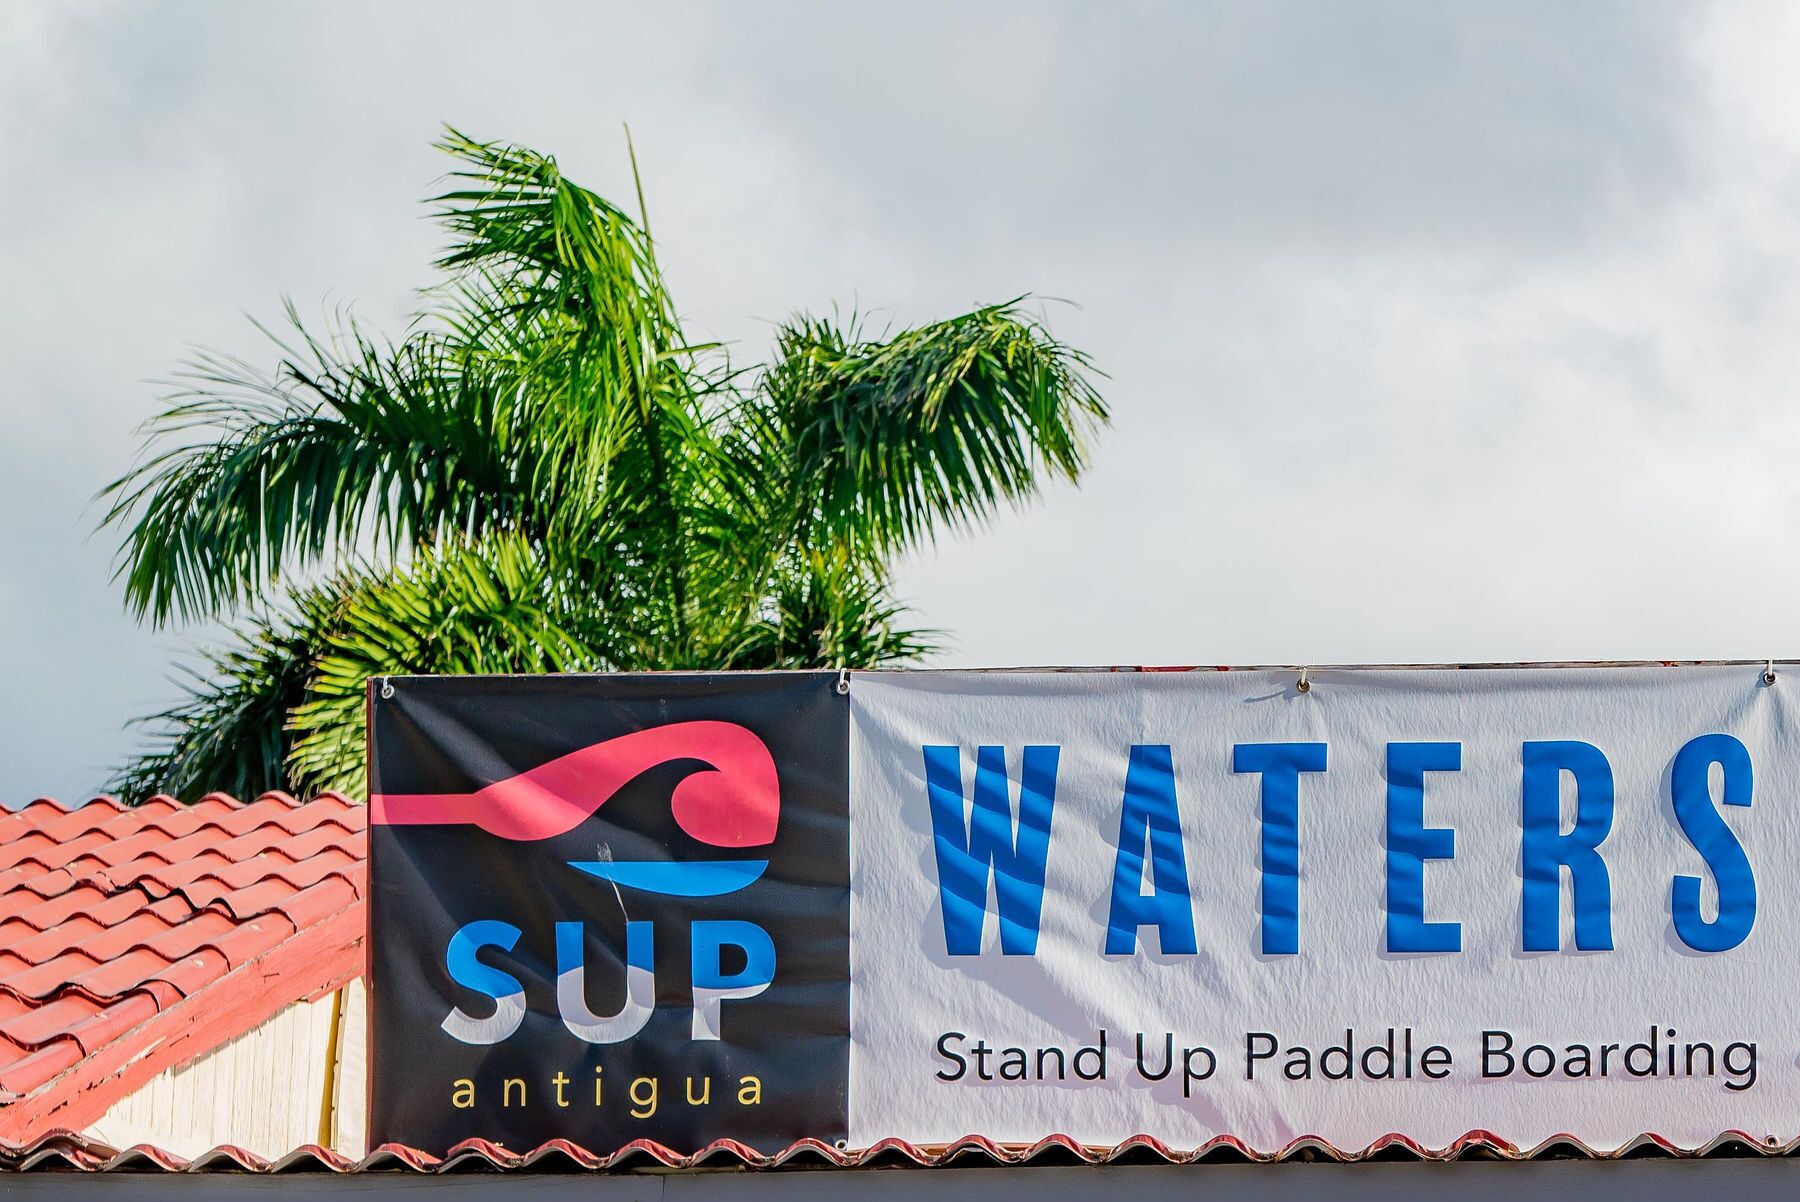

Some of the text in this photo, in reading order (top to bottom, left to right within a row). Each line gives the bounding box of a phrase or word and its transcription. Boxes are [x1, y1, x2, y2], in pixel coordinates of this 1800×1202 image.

[441, 919, 777, 1046] SUP
[451, 1066, 763, 1120] antigua
[935, 1030, 1107, 1082] Stand
[1135, 1033, 1217, 1099] Up
[1246, 1028, 1453, 1081] Paddle
[1481, 1025, 1758, 1091] Boarding
